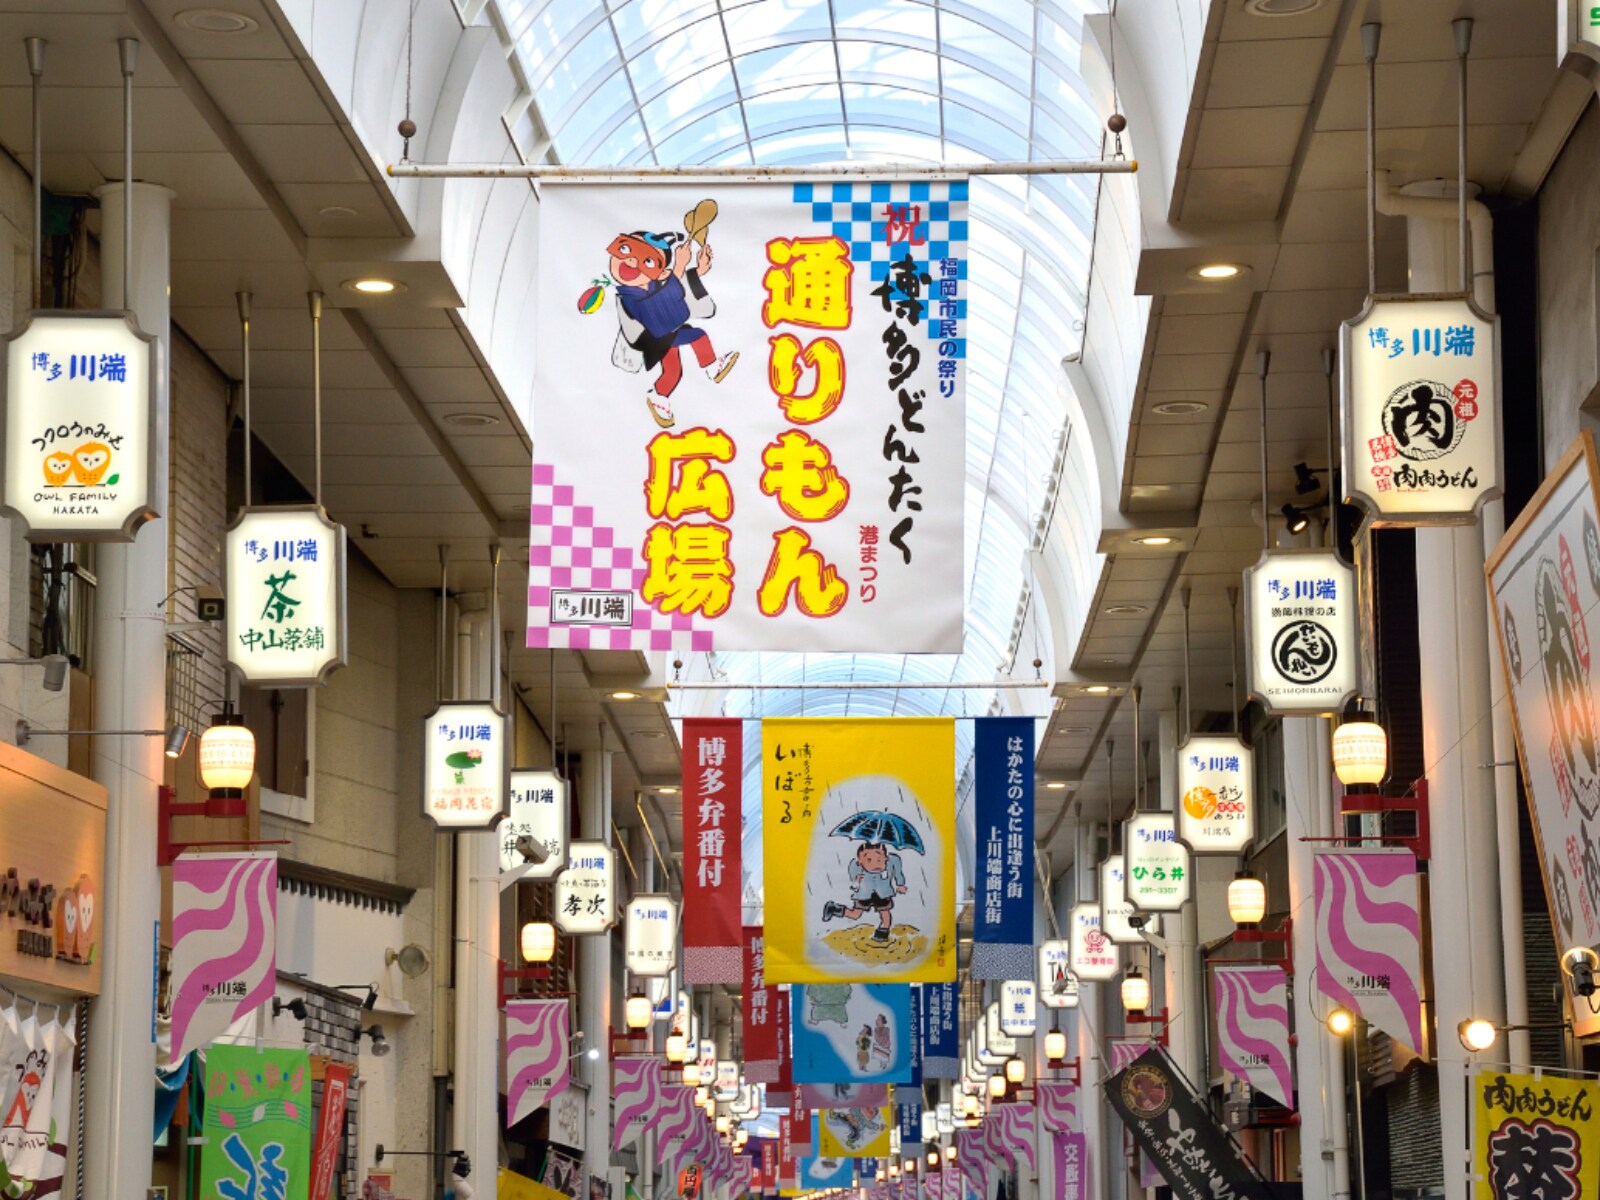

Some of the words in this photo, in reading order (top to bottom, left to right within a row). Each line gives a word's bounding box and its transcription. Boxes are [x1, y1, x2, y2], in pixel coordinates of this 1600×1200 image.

[881, 204, 926, 247] 祝
[938, 257, 959, 398] 福岡市民の祭り
[1368, 325, 1476, 359] 博多川端
[32, 352, 127, 383] 博多川端
[869, 253, 933, 565] 博多どんたく
[1390, 384, 1455, 449] 肉
[1458, 383, 1475, 417] 元祖
[757, 234, 855, 618] 通りもん
[33, 492, 62, 502] OWL
[69, 492, 117, 502] FAMILY
[1393, 463, 1479, 489] 肉肉うどん
[53, 506, 99, 515] HAKATA
[640, 426, 736, 619] 広場
[244, 538, 318, 563] 博多川端
[858, 525, 878, 604] 港まつり
[260, 570, 301, 624] 茶
[1268, 578, 1336, 601] 博多川端
[697, 737, 727, 888] 博多弁番付
[1007, 736, 1024, 899] はかたの心に出逢う街
[985, 826, 1003, 925] 上川端商店街
[1132, 866, 1185, 880] ひら井
[562, 894, 605, 916] 孝次
[1484, 1075, 1592, 1121] 肉肉うどん
